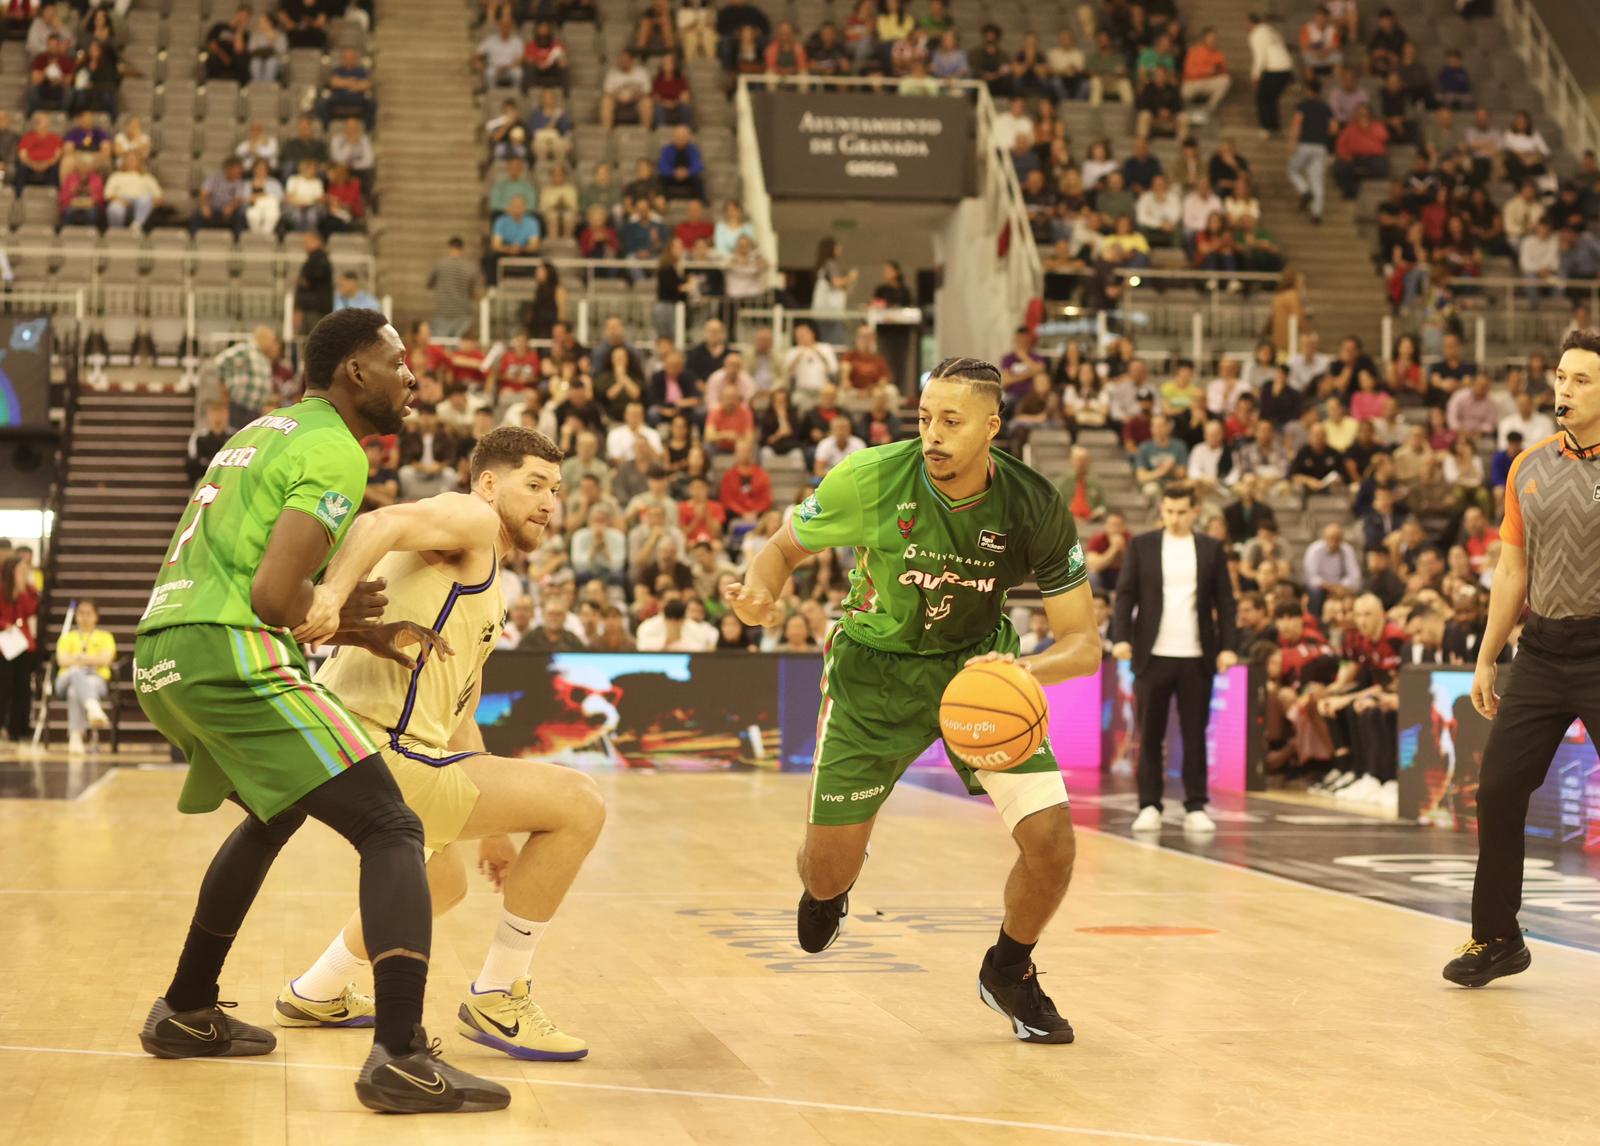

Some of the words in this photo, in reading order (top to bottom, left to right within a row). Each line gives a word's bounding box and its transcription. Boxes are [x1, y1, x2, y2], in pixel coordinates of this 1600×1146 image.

[896, 502, 917, 510] vive
[167, 482, 222, 566] 7
[821, 793, 845, 802] vive
[850, 786, 879, 801] asisa
